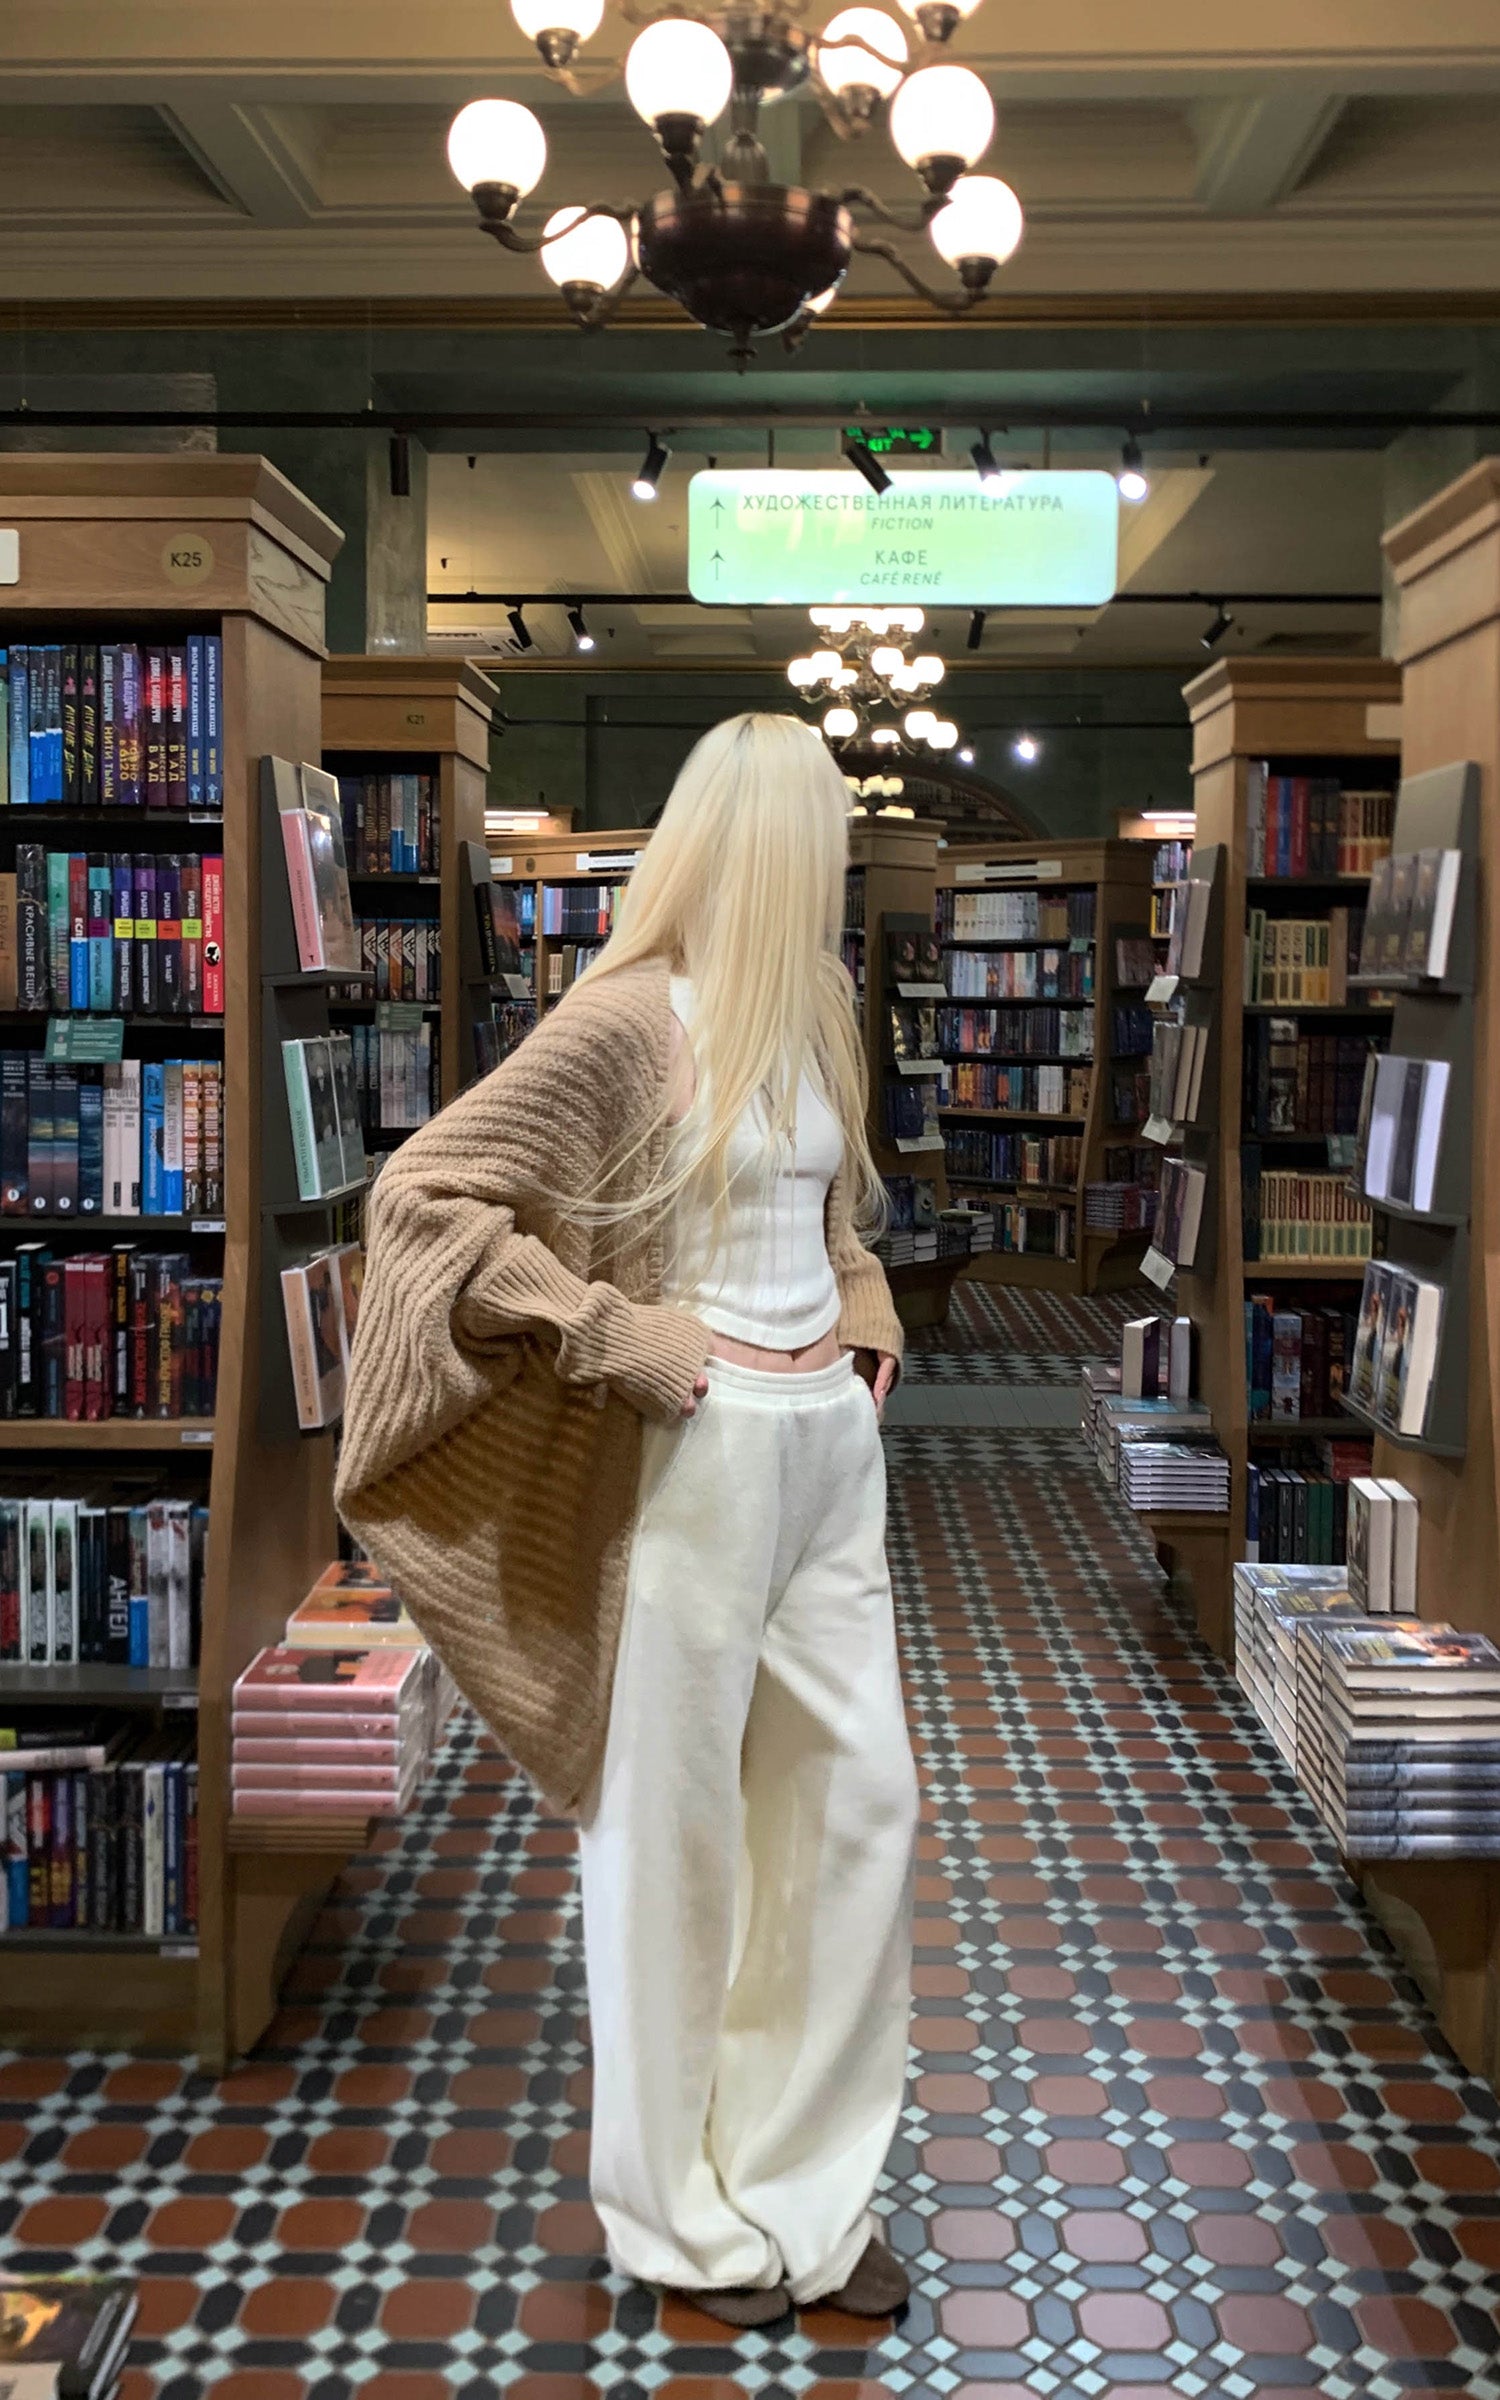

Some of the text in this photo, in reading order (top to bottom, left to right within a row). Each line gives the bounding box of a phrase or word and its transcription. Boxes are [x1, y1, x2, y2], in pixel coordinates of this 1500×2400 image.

[743, 494, 1064, 512] ХУДОЖЕСТВЕННАЯ ЛИТЕРАТУРА
[871, 517, 934, 530] FICTION
[875, 549, 928, 565] КАФЕ
[860, 571, 942, 586] CAFÉ RENÉ
[191, 646, 199, 682] ВОЛЧЬЕ
[208, 646, 216, 737] ВОЛЧЬЕ КЛАДБИЩЕ
[103, 726, 114, 759] НИТИ
[103, 763, 114, 798] ТЬМЫ
[24, 905, 35, 999] КРАСИВЫЕ ВЕЩИ
[109, 1575, 129, 1639] АНГЕЛ
